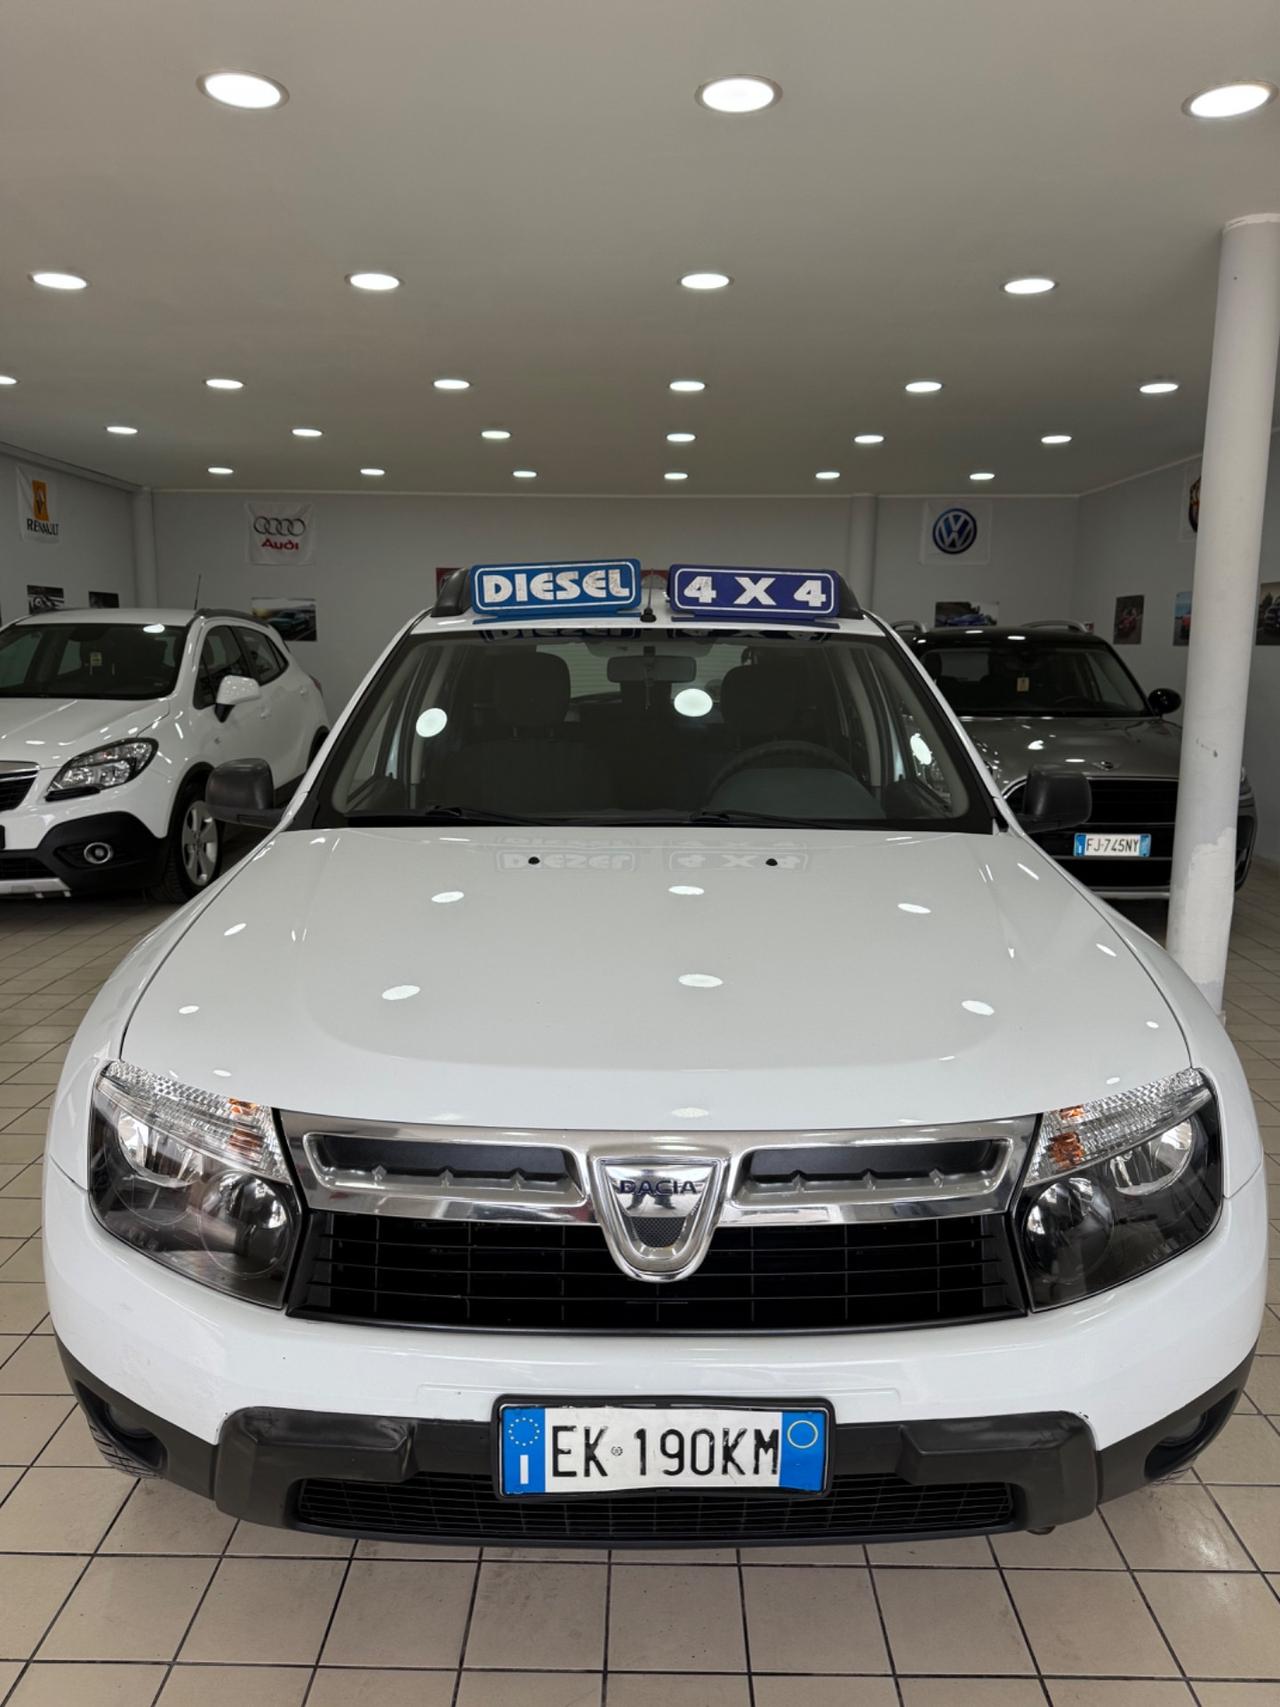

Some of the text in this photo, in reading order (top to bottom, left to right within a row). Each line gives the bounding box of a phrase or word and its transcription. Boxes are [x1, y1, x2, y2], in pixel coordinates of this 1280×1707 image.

[262, 538, 299, 550] Audi
[483, 569, 630, 603] DIESEL
[683, 576, 827, 607] 4 X 4
[620, 1180, 697, 1194] DACIA
